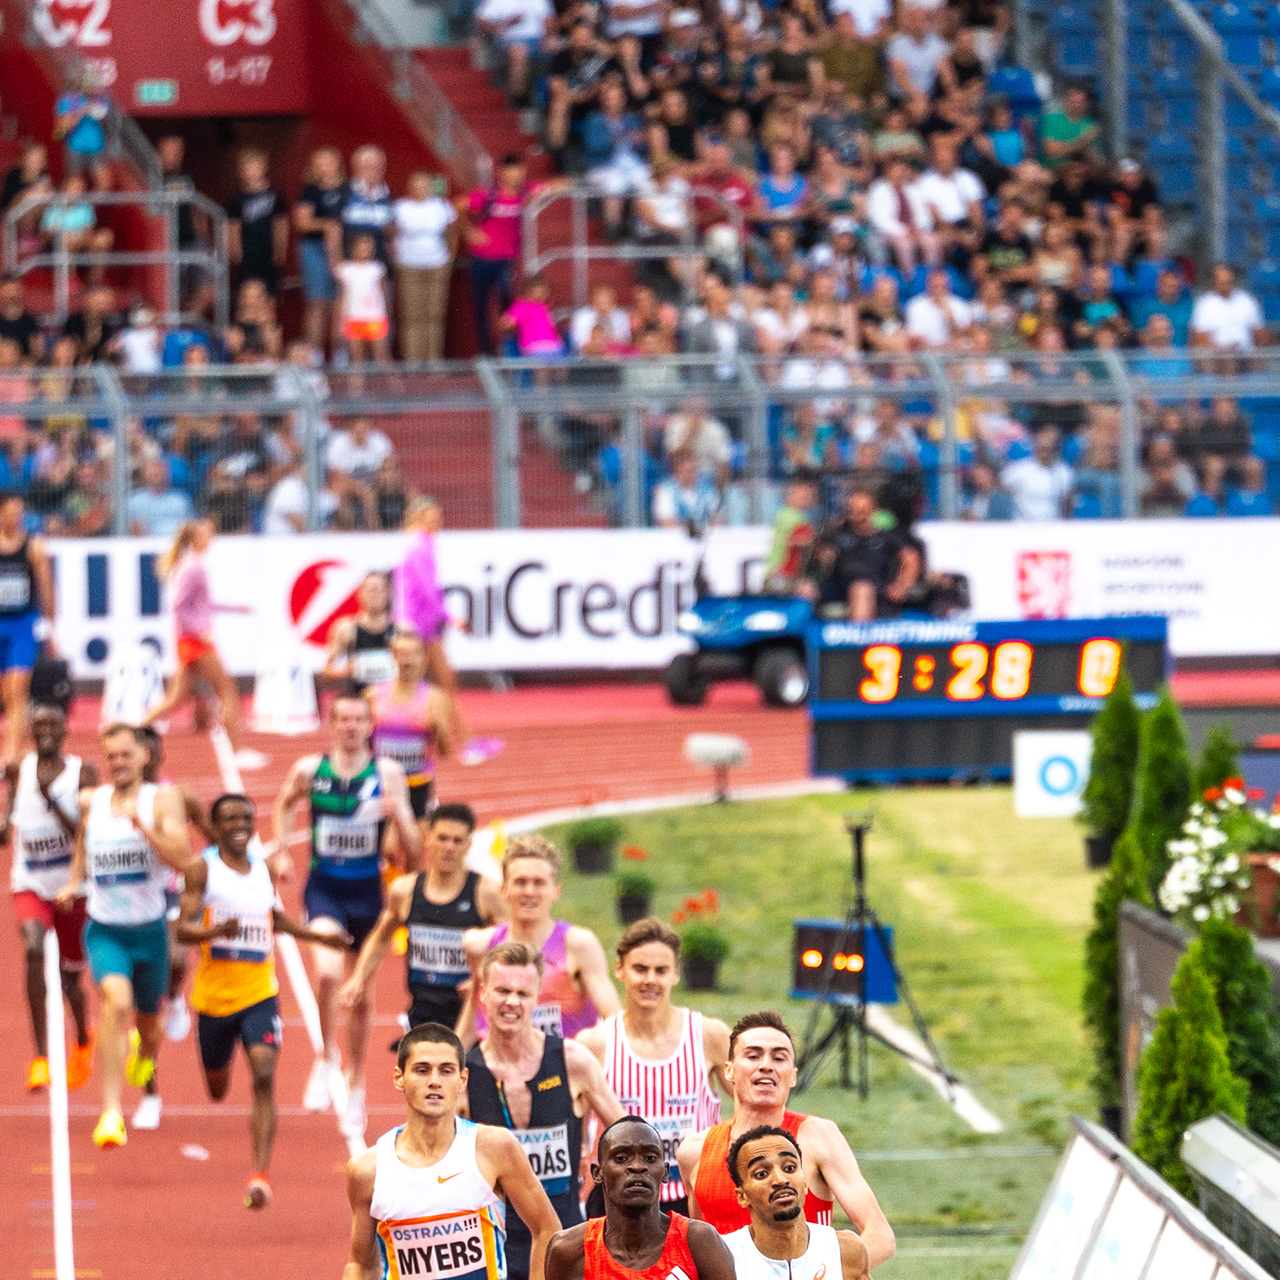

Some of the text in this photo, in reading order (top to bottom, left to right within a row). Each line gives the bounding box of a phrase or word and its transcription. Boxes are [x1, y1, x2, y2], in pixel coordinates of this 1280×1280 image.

[200, 0, 277, 45] C3
[860, 643, 1033, 702] 3:28
[393, 1217, 478, 1241] OSTRAVA!!!
[397, 1236, 483, 1275] MYERS
